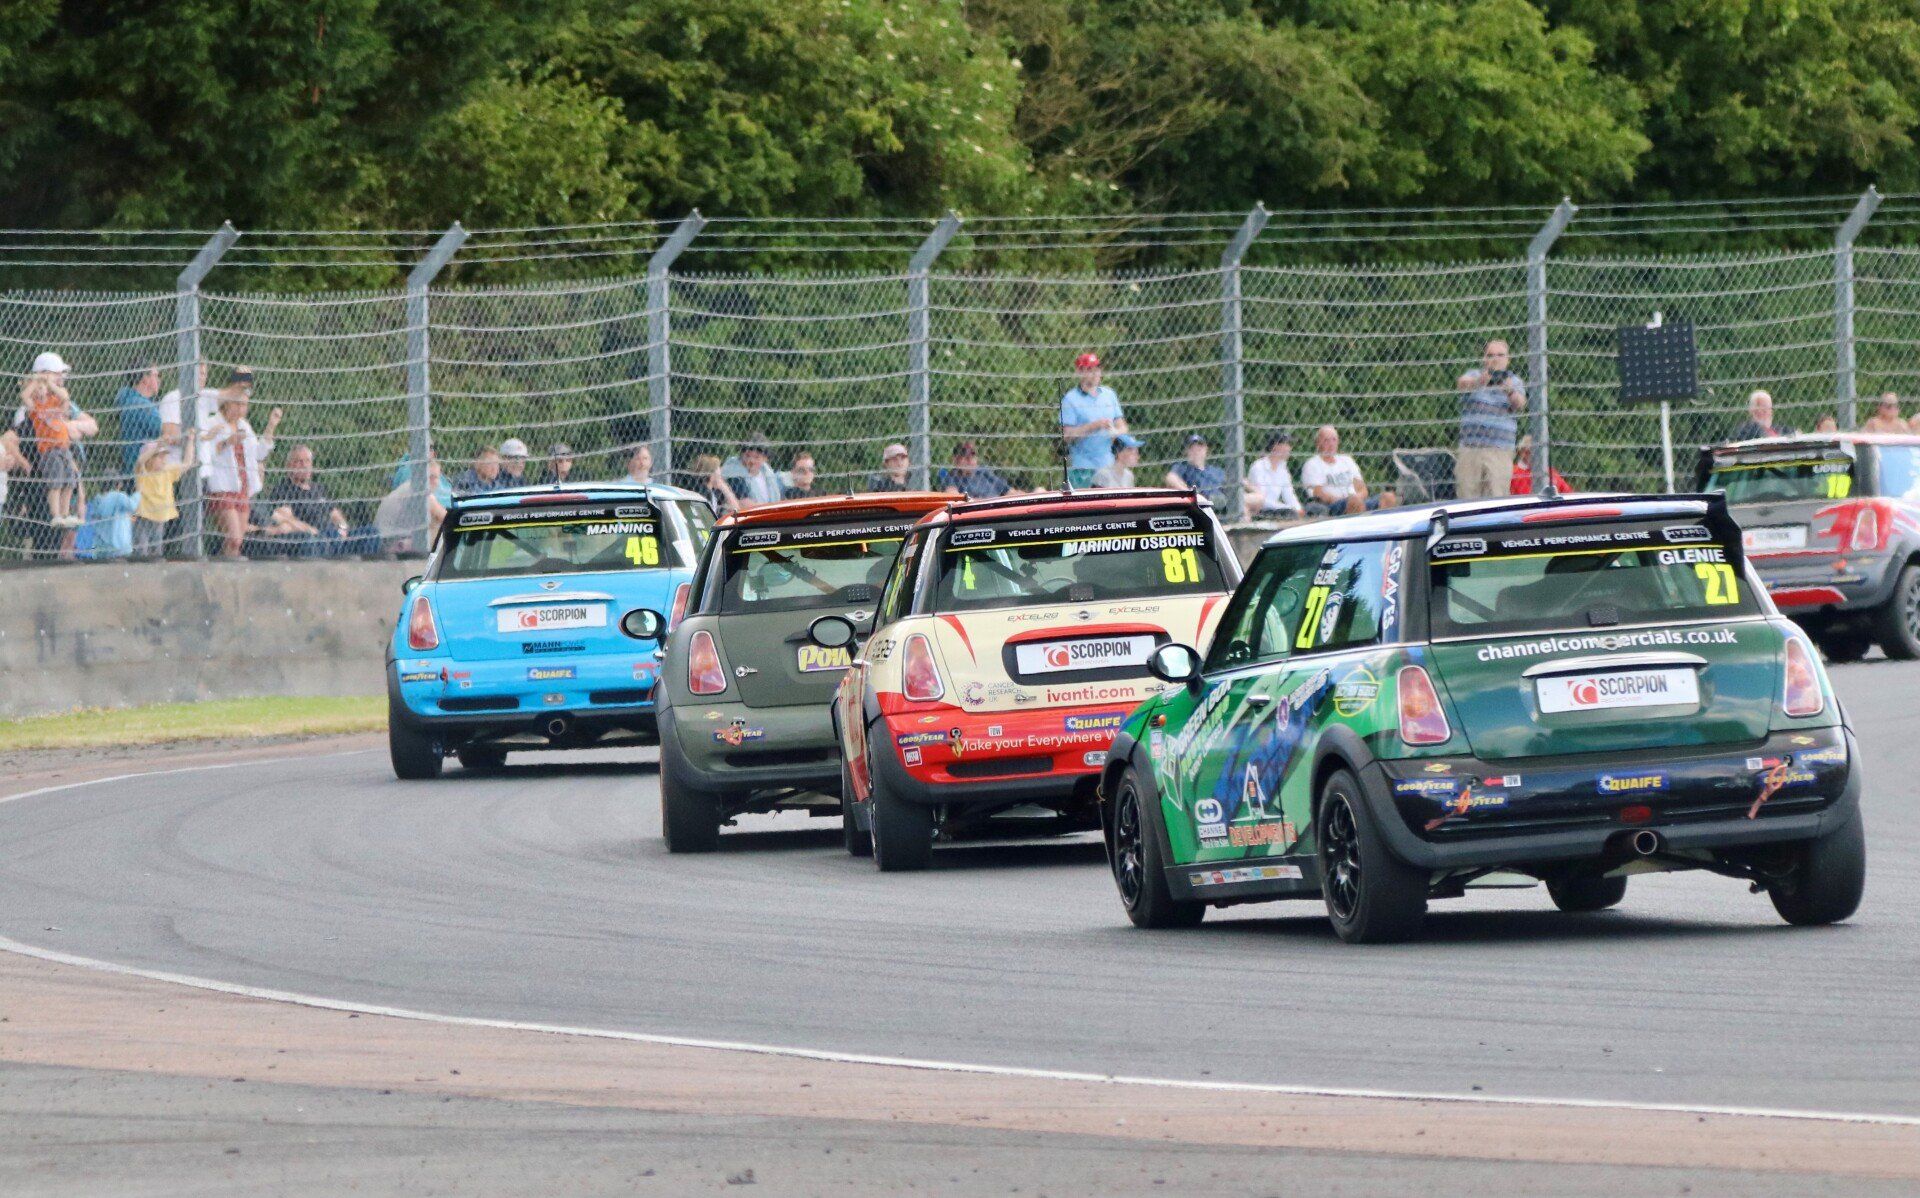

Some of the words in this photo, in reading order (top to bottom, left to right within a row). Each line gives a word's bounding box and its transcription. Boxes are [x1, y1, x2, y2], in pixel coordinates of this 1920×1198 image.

[502, 513, 528, 521] VEHICLE
[529, 509, 577, 519] PERFORMANCE
[578, 508, 605, 517] CENTRE
[1152, 518, 1191, 528] HYBRID
[586, 523, 654, 535] MANNING
[792, 530, 823, 540] VEHICLE
[826, 526, 882, 537] PERFORMANCE
[954, 532, 993, 542] HYBRID
[1007, 527, 1041, 538] VEHICLE
[1044, 524, 1103, 535] PERFORMANCE
[1105, 521, 1138, 531] CENTRE
[1667, 528, 1708, 540] HYBRID
[1062, 538, 1136, 557] MARINONI
[1140, 535, 1205, 550] OSBORNE
[1437, 541, 1482, 554] HYBRID
[1501, 538, 1542, 548] VEHICLE
[1544, 534, 1611, 546] PERFORMANCE
[1614, 531, 1651, 541] CENTRE
[625, 536, 659, 566] 46
[1659, 549, 1726, 566] GLENIE
[1161, 548, 1200, 583] 81
[1382, 546, 1402, 630] GRAVES
[1694, 563, 1740, 605] 27
[539, 608, 587, 622] SCORPION
[1296, 586, 1331, 648] 27
[1070, 641, 1132, 660] SCORPION
[988, 688, 1021, 696] RESEARCH
[1599, 674, 1668, 695] SCORPION
[1046, 685, 1135, 704] ivanti.com
[1075, 716, 1121, 730] QUAIFE
[994, 737, 1023, 752] your
[1027, 731, 1102, 750] Everywhere
[1397, 780, 1454, 792] GOODYEAR
[1608, 775, 1662, 792] QUAIFE
[1228, 821, 1298, 847] DEVELOPMENTS
